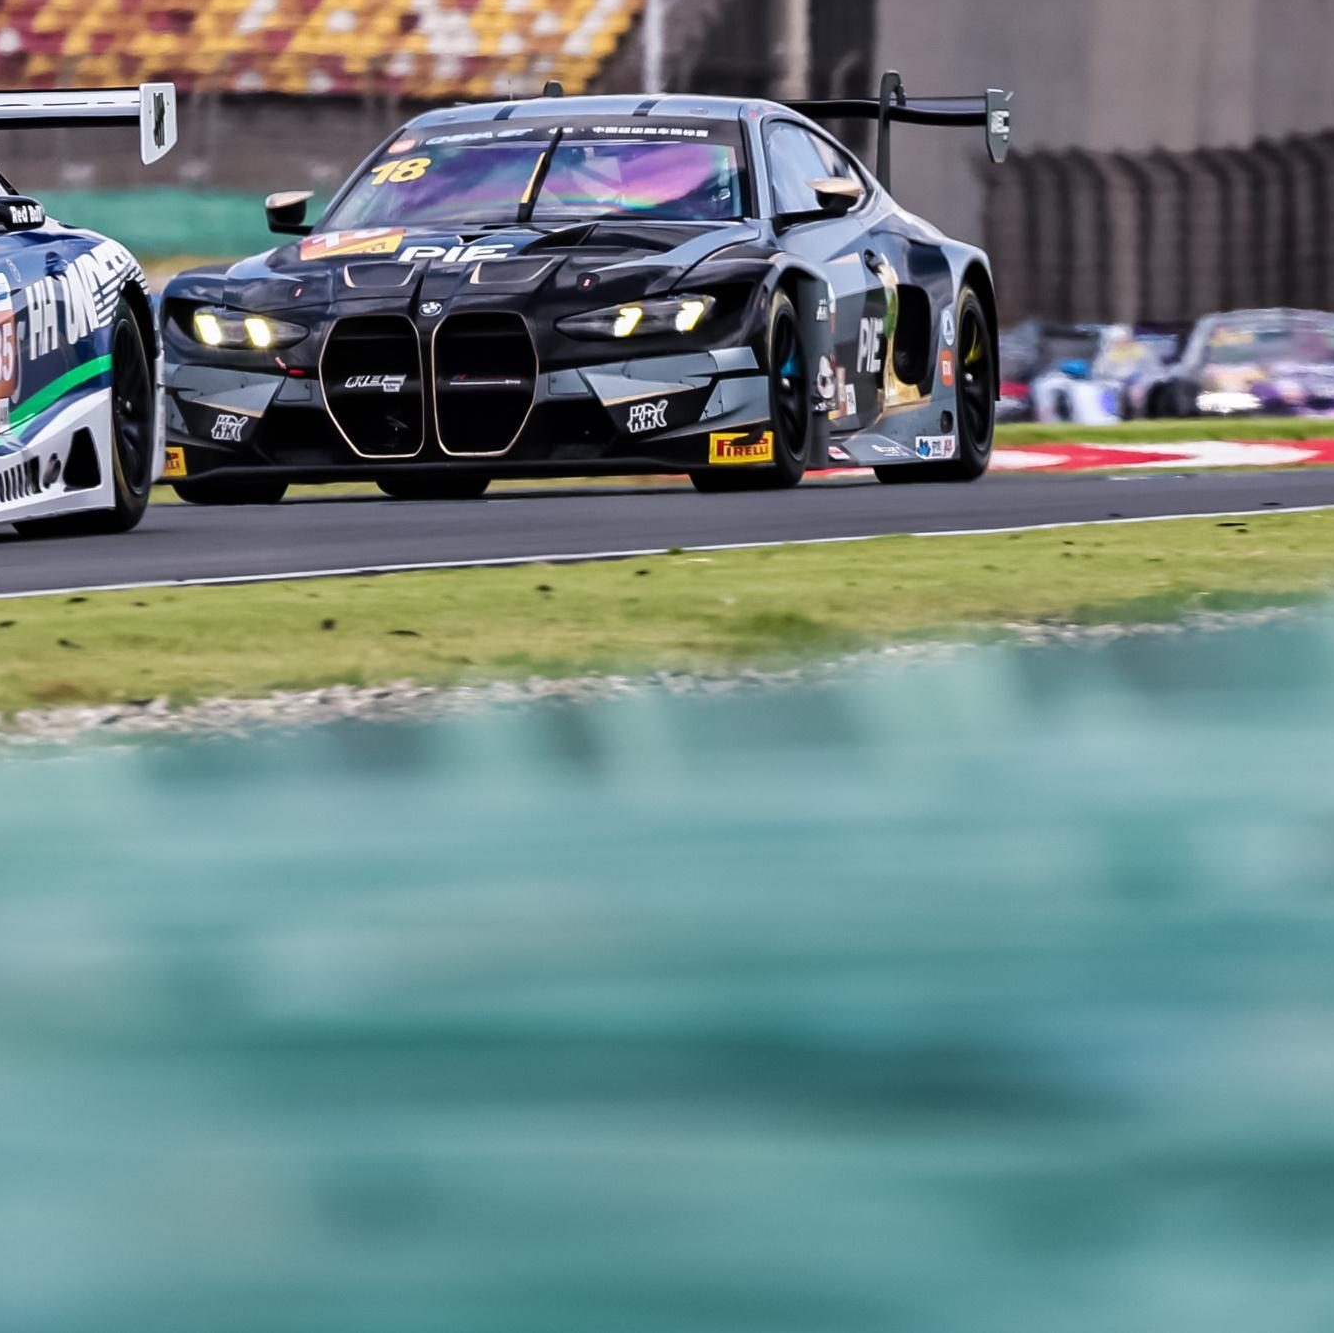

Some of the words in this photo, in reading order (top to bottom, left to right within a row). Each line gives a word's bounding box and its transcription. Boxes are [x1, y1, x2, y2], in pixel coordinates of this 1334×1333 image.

[371, 157, 432, 186] 18
[9, 204, 29, 224] Red
[397, 243, 515, 263] PIE
[856, 316, 884, 374] PIE
